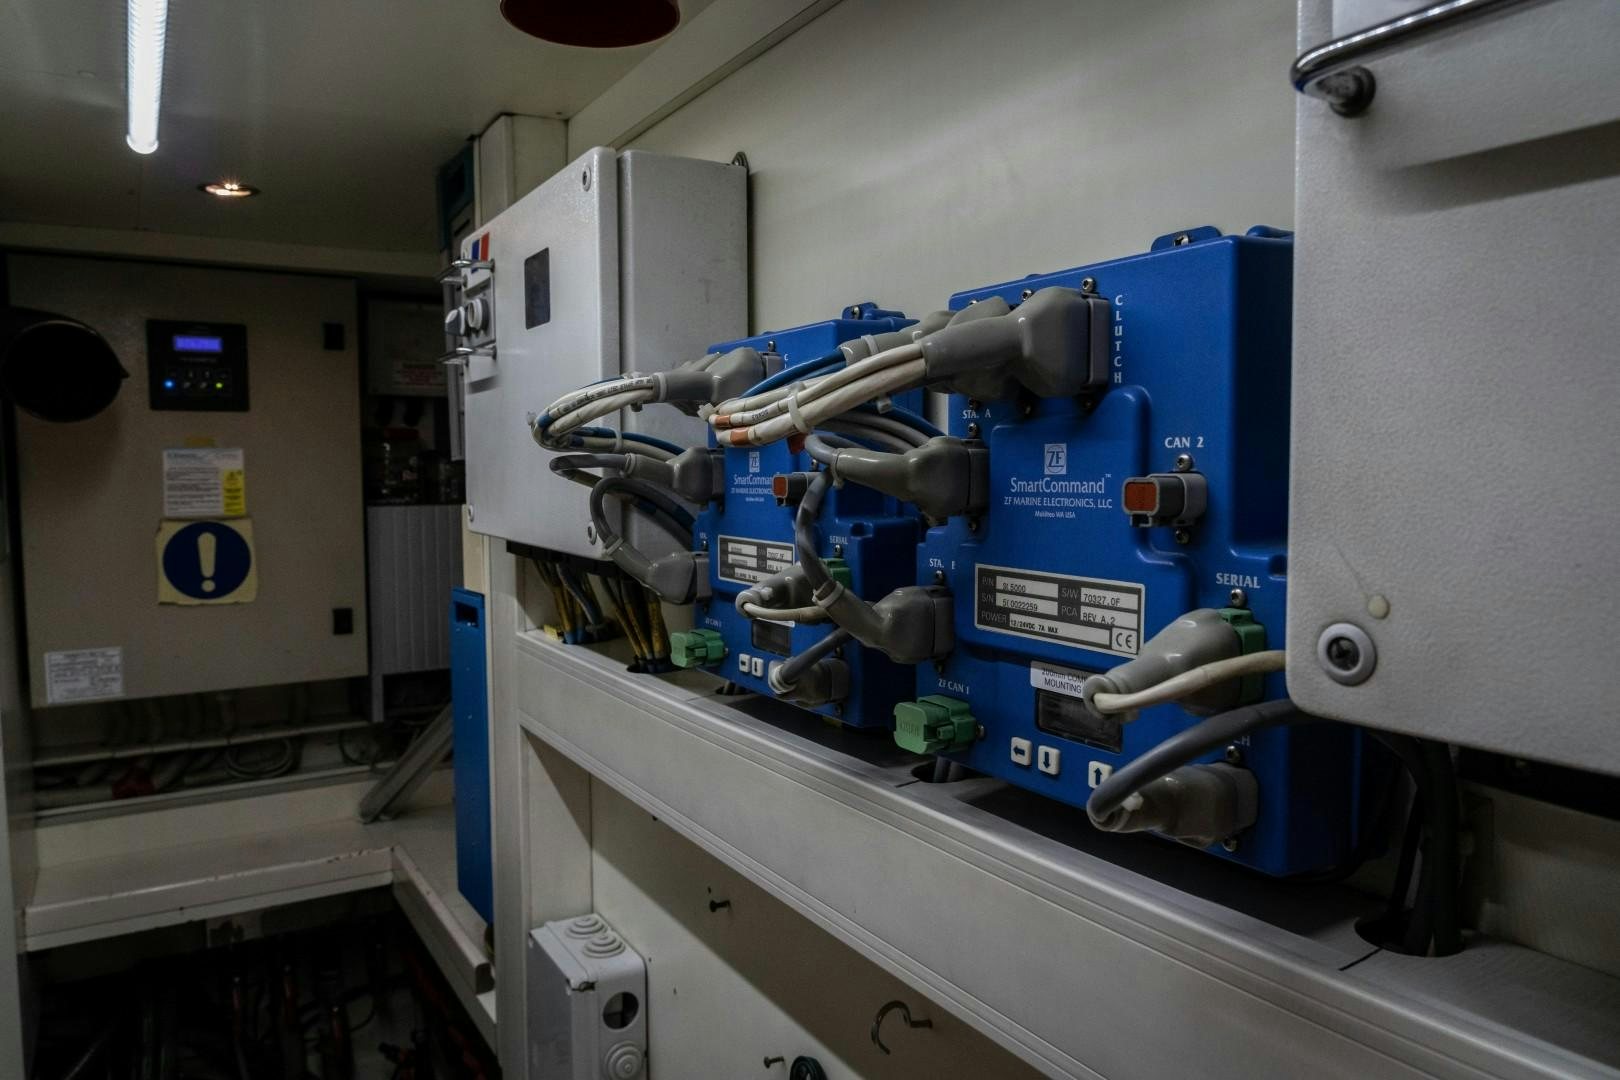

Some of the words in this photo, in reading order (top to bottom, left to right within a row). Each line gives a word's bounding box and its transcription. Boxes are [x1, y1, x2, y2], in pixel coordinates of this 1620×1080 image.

[1113, 294, 1124, 384] CLUTCH
[1164, 436, 1191, 448] CAN
[1196, 436, 1205, 448] 2
[1010, 477, 1105, 493] SmartCommand
[1004, 496, 1012, 505] ZF
[1013, 497, 1042, 506] MARINE
[1043, 498, 1096, 508] ELECTRONICS,
[1097, 499, 1113, 508] LLC
[1215, 572, 1261, 589] SERIAL
[981, 610, 1007, 624] POWER
[1061, 605, 1078, 617] PCA
[1044, 677, 1082, 694] MOUNTING
